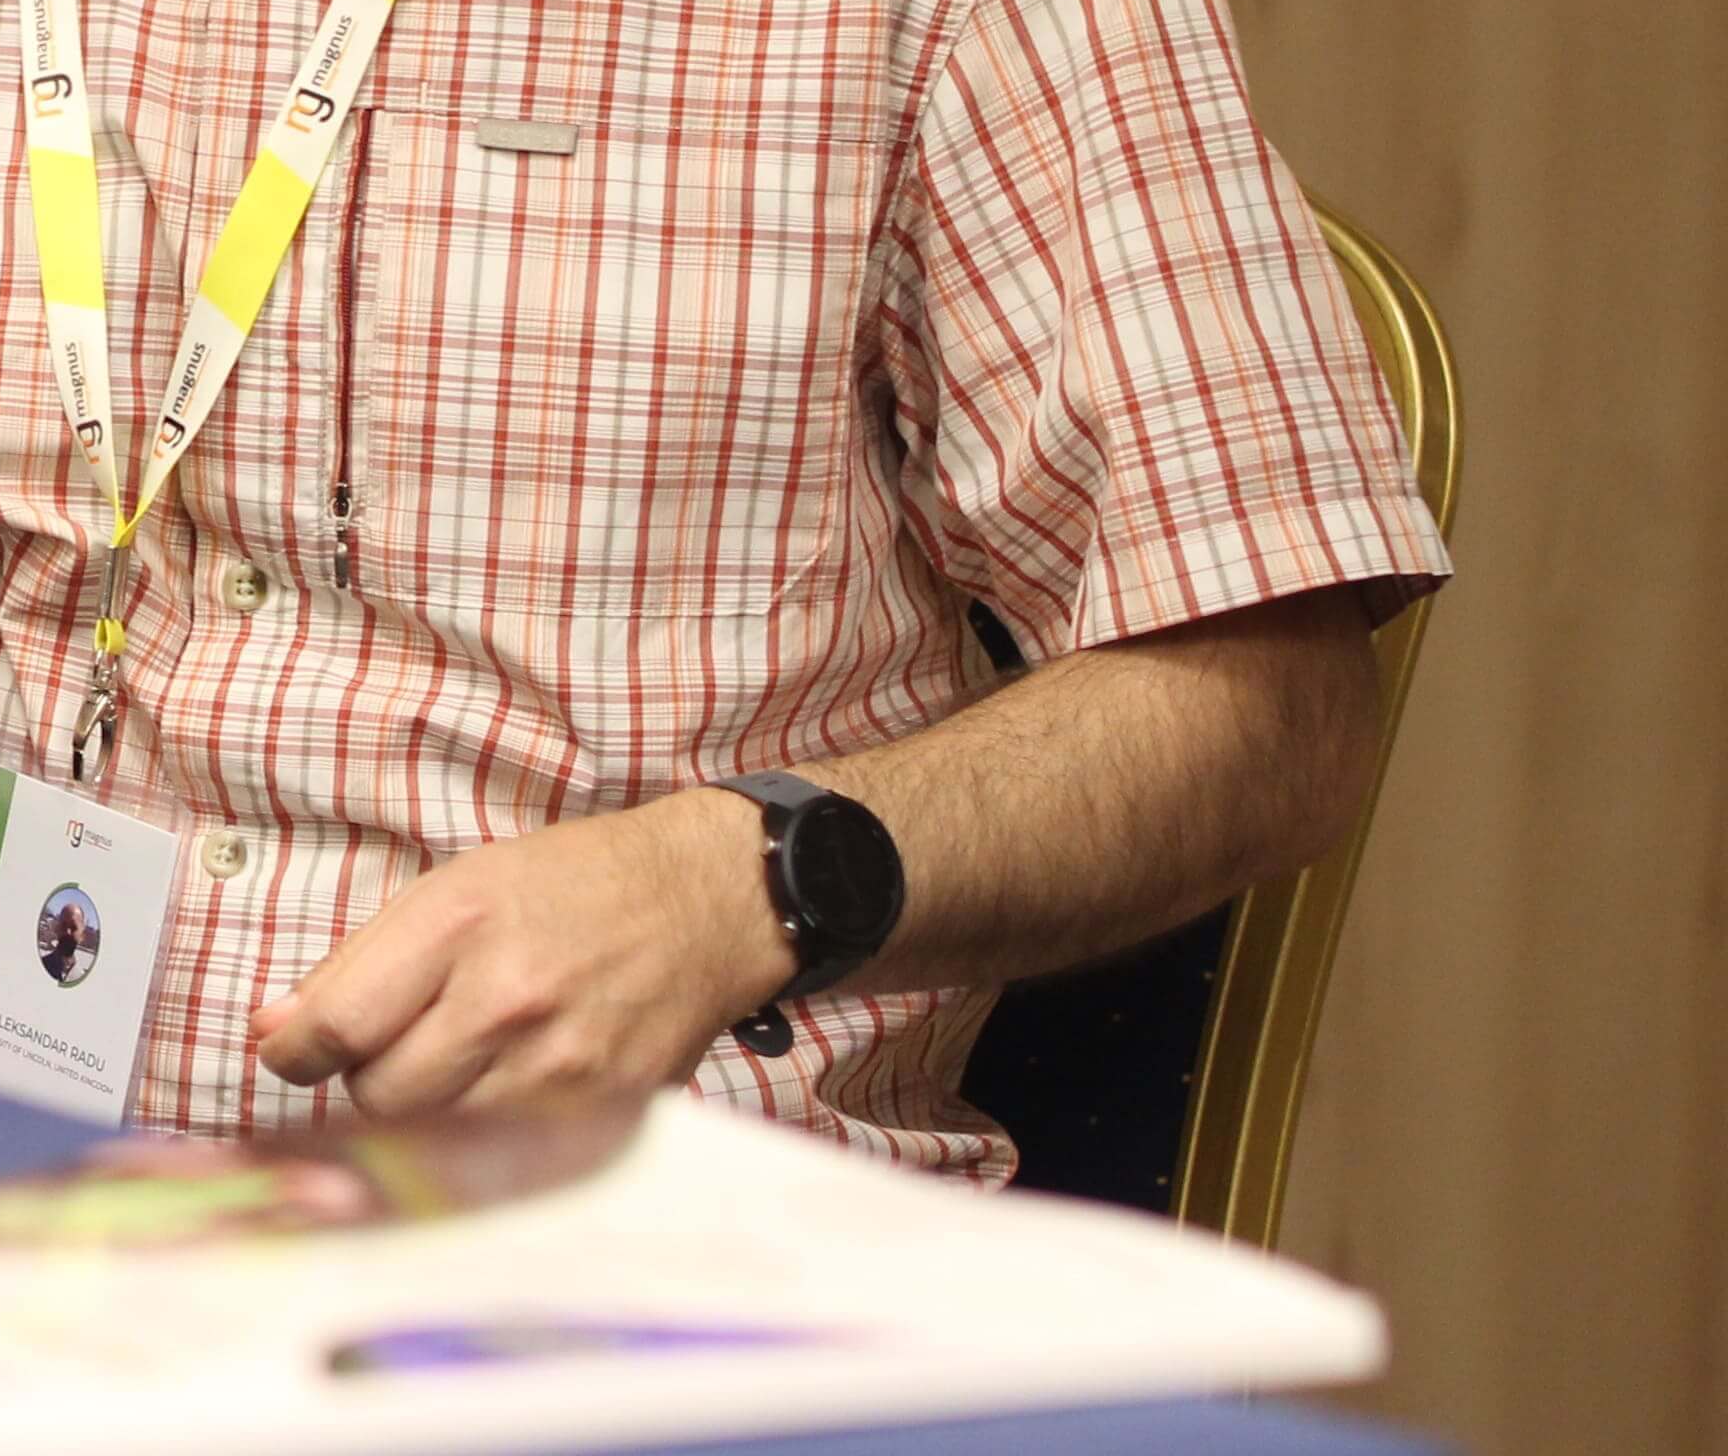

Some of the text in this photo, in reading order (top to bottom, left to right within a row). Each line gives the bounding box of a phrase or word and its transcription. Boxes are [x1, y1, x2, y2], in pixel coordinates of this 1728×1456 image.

[312, 15, 352, 87] magnus
[65, 341, 87, 418] magnus
[172, 342, 206, 415] magnus
[70, 1046, 106, 1072] RADU
